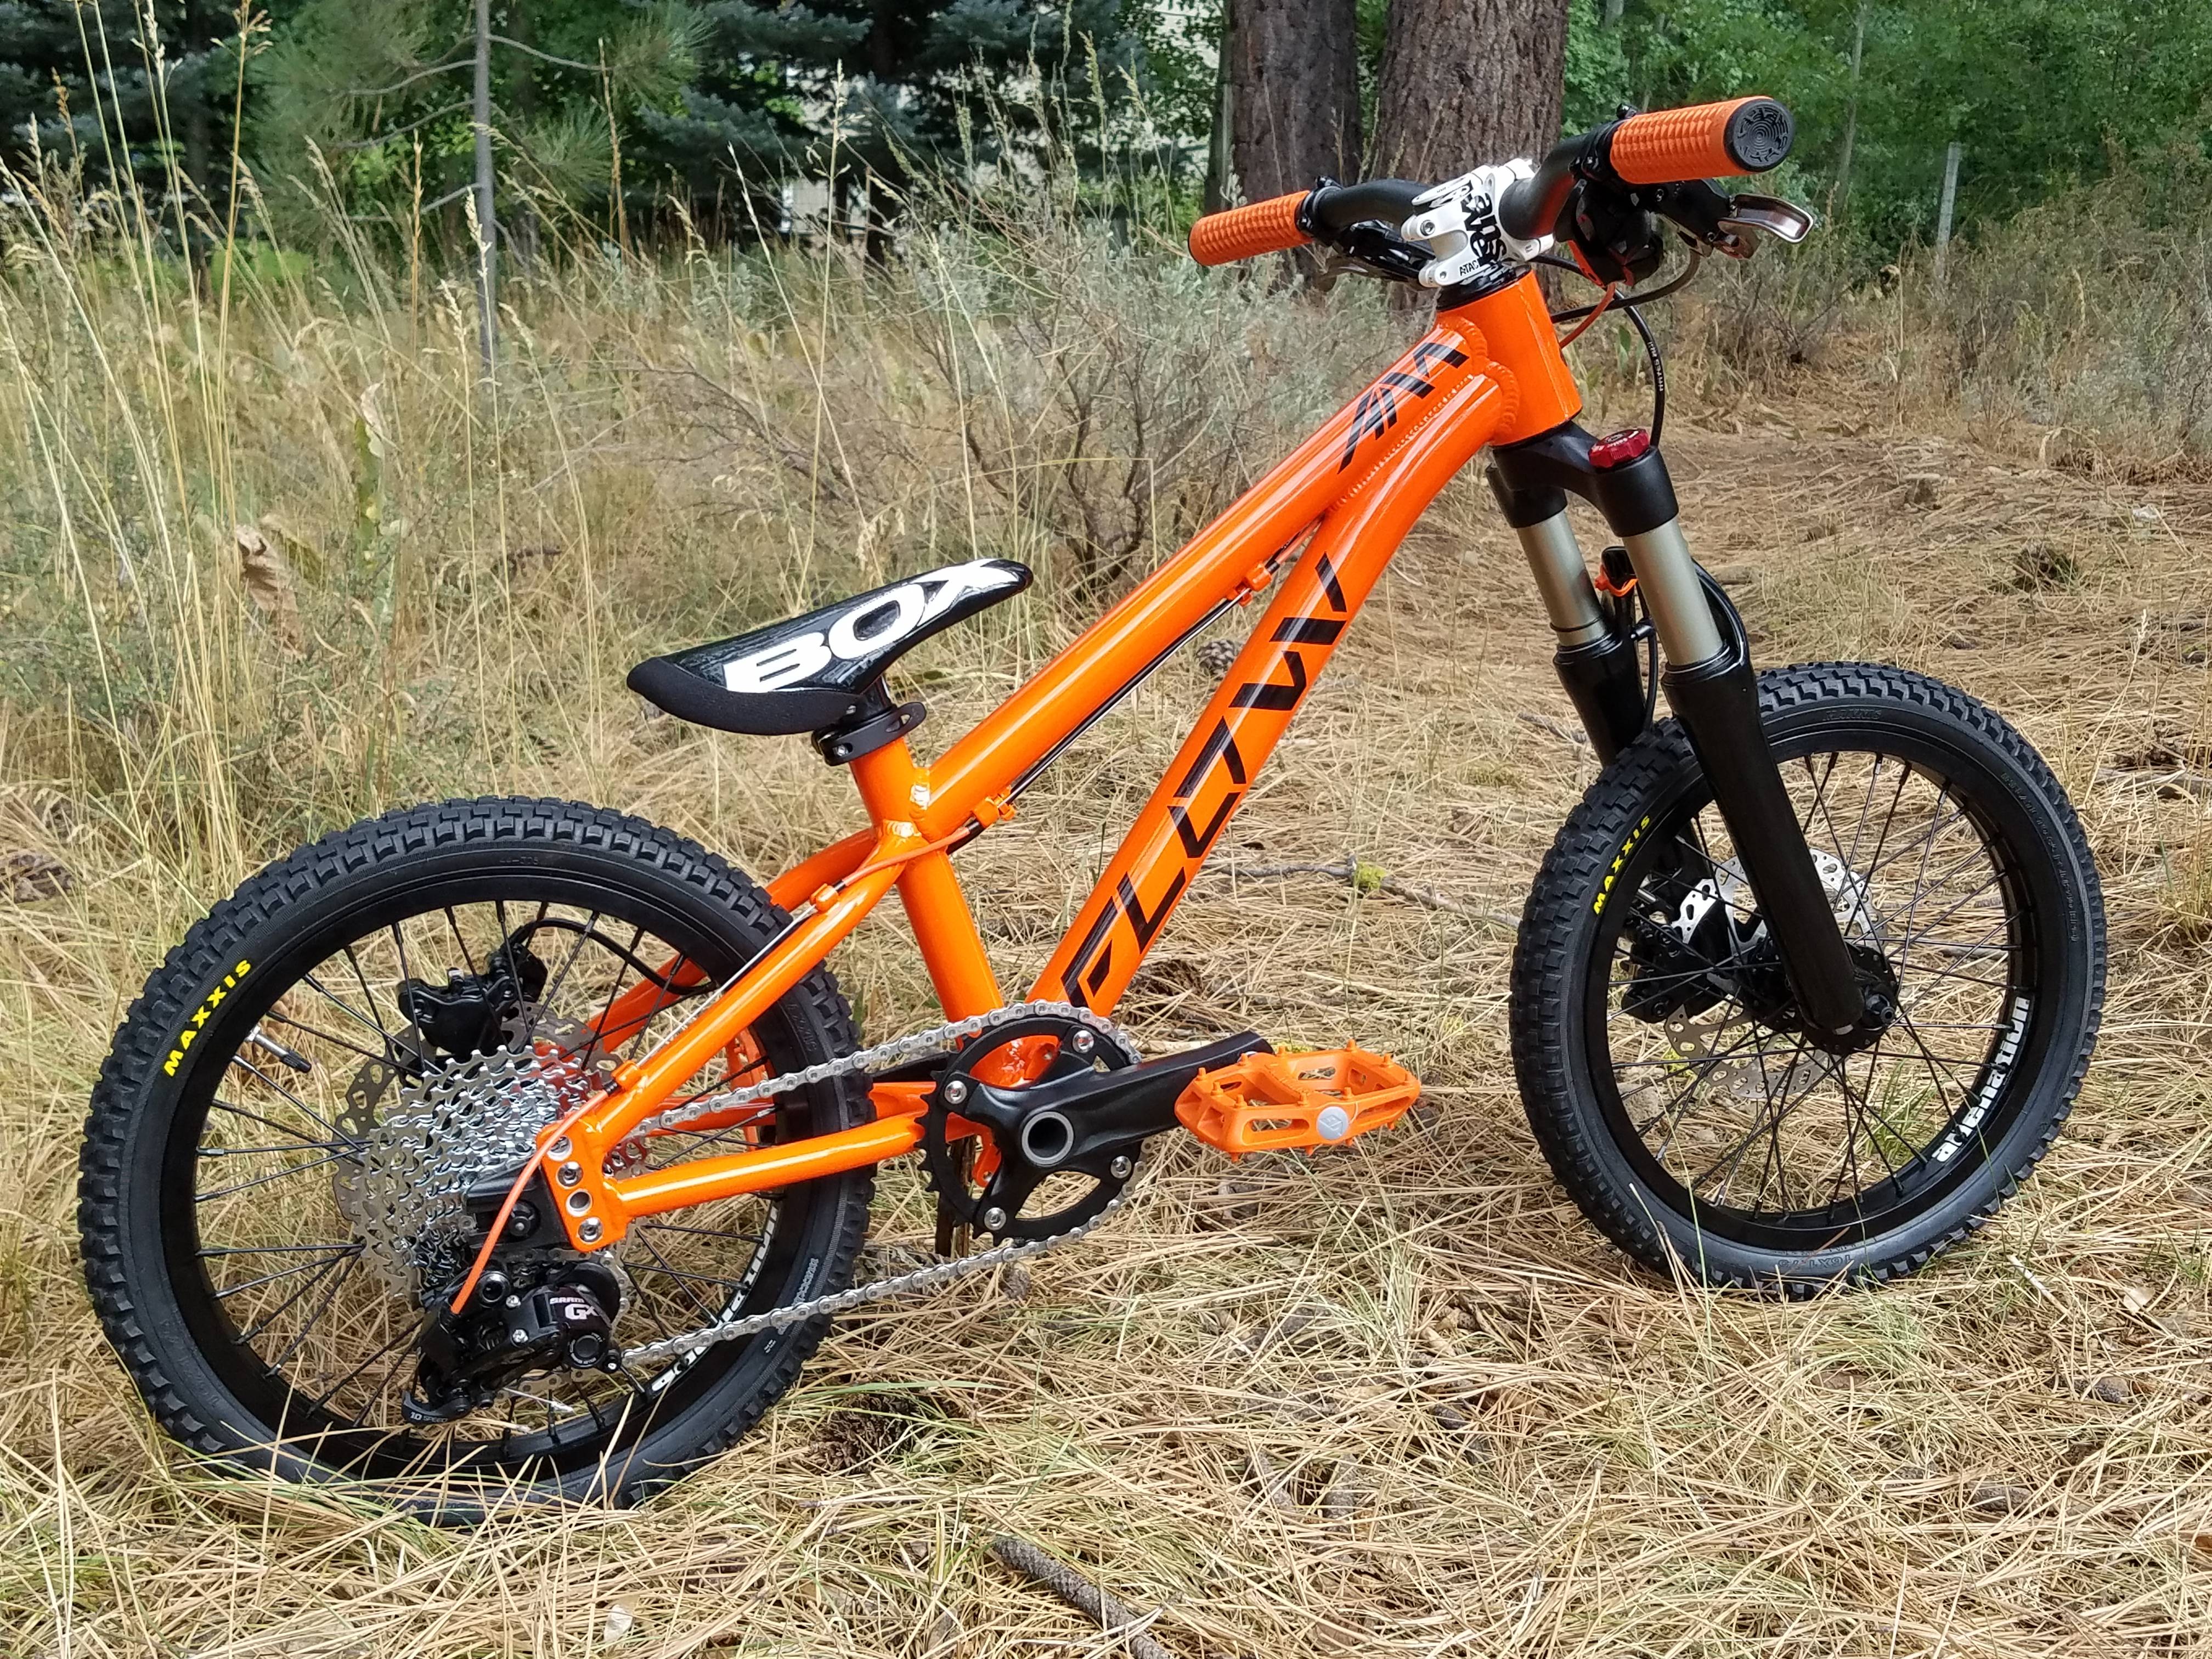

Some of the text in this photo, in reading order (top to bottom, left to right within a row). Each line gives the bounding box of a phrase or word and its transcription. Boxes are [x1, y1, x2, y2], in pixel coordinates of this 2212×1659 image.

[1459, 259, 1480, 276] ATAC
[722, 558, 1022, 693] BOX
[1061, 551, 1348, 1008] FLOW
[1593, 815, 1651, 915] MAXXIS
[163, 960, 251, 1076] MAXXIS
[1932, 996, 2030, 1163] alienation
[549, 1296, 585, 1305] SRAM
[565, 1303, 600, 1319] GX
[410, 1411, 422, 1421] 10
